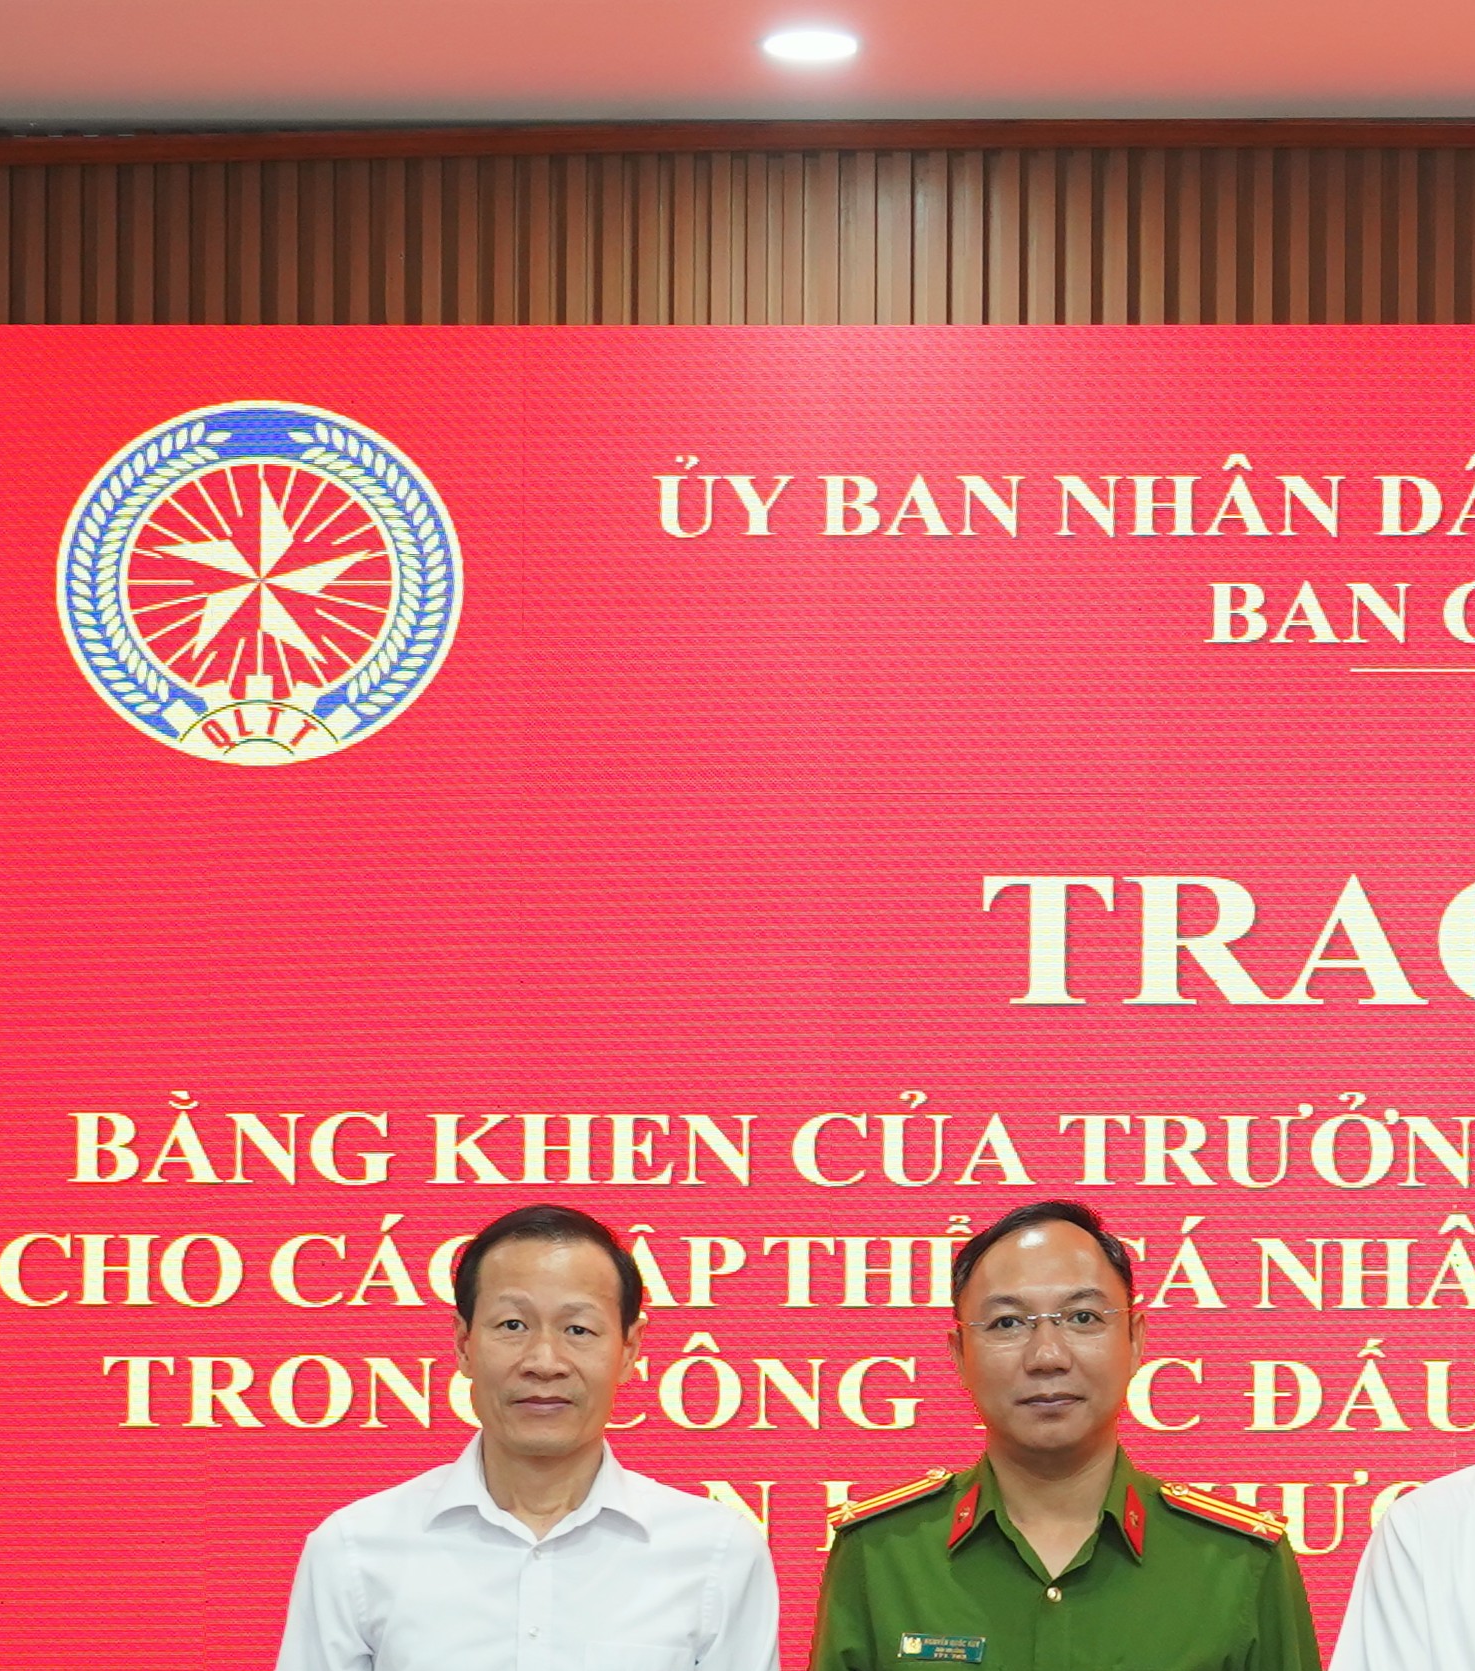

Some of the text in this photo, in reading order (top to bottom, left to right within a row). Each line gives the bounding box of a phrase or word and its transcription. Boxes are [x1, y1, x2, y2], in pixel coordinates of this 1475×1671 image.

[655, 454, 792, 537] ỦY
[820, 474, 1023, 537] BAN
[1055, 453, 1342, 537] NHÂN
[1211, 581, 1407, 643] BAN
[201, 707, 317, 749] QLTT
[69, 1091, 394, 1186] BẰNG
[431, 1114, 756, 1187] KHEN
[792, 1091, 1035, 1188] CỦA
